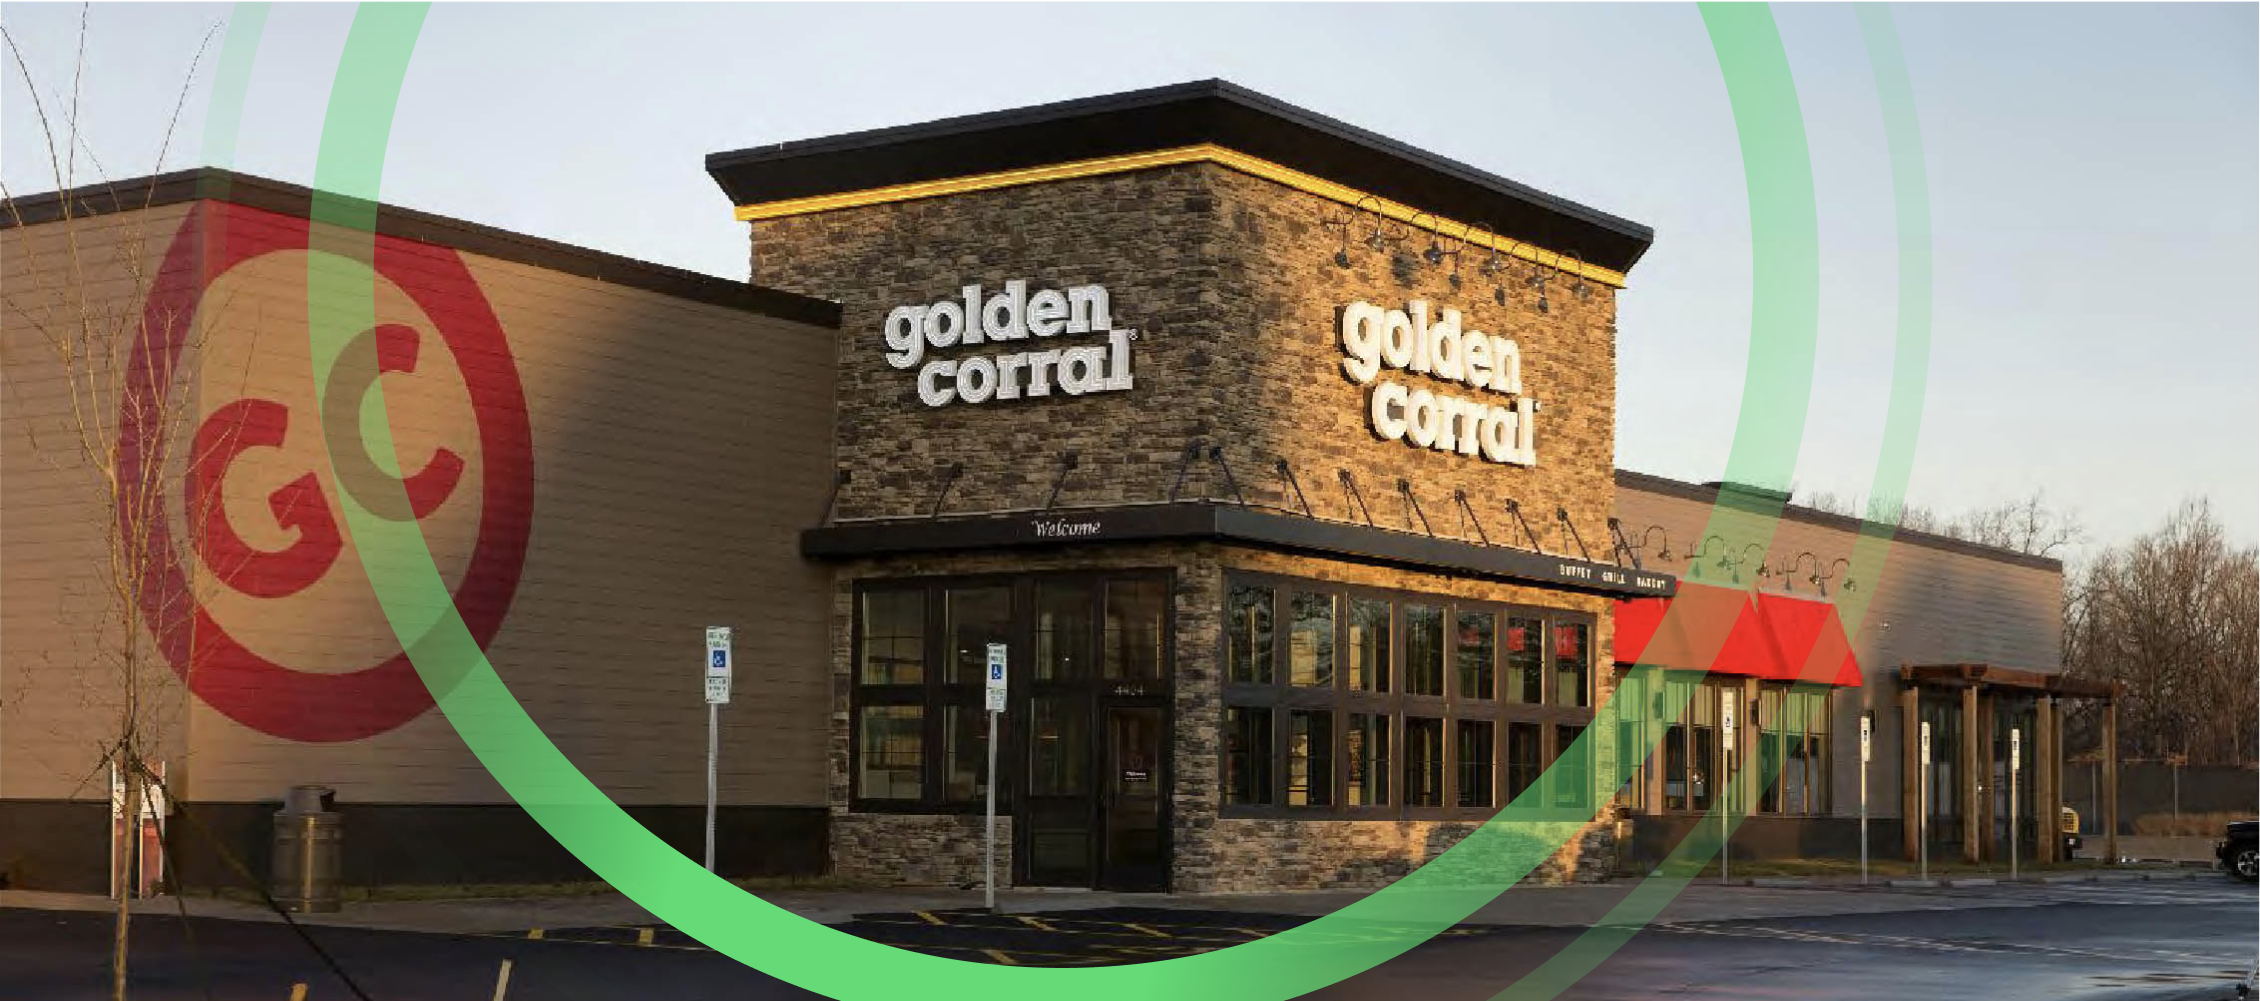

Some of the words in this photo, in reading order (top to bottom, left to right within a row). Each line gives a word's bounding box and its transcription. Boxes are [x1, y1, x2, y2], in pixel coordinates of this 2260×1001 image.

[885, 279, 1113, 369] golden
[1341, 300, 1523, 395] golden
[917, 329, 1134, 407] corral
[185, 322, 466, 599] GC
[1371, 381, 1537, 466] corral
[1030, 518, 1101, 538] Welcome
[1560, 564, 1591, 579] BUFFET
[1602, 571, 1626, 584] GRILL
